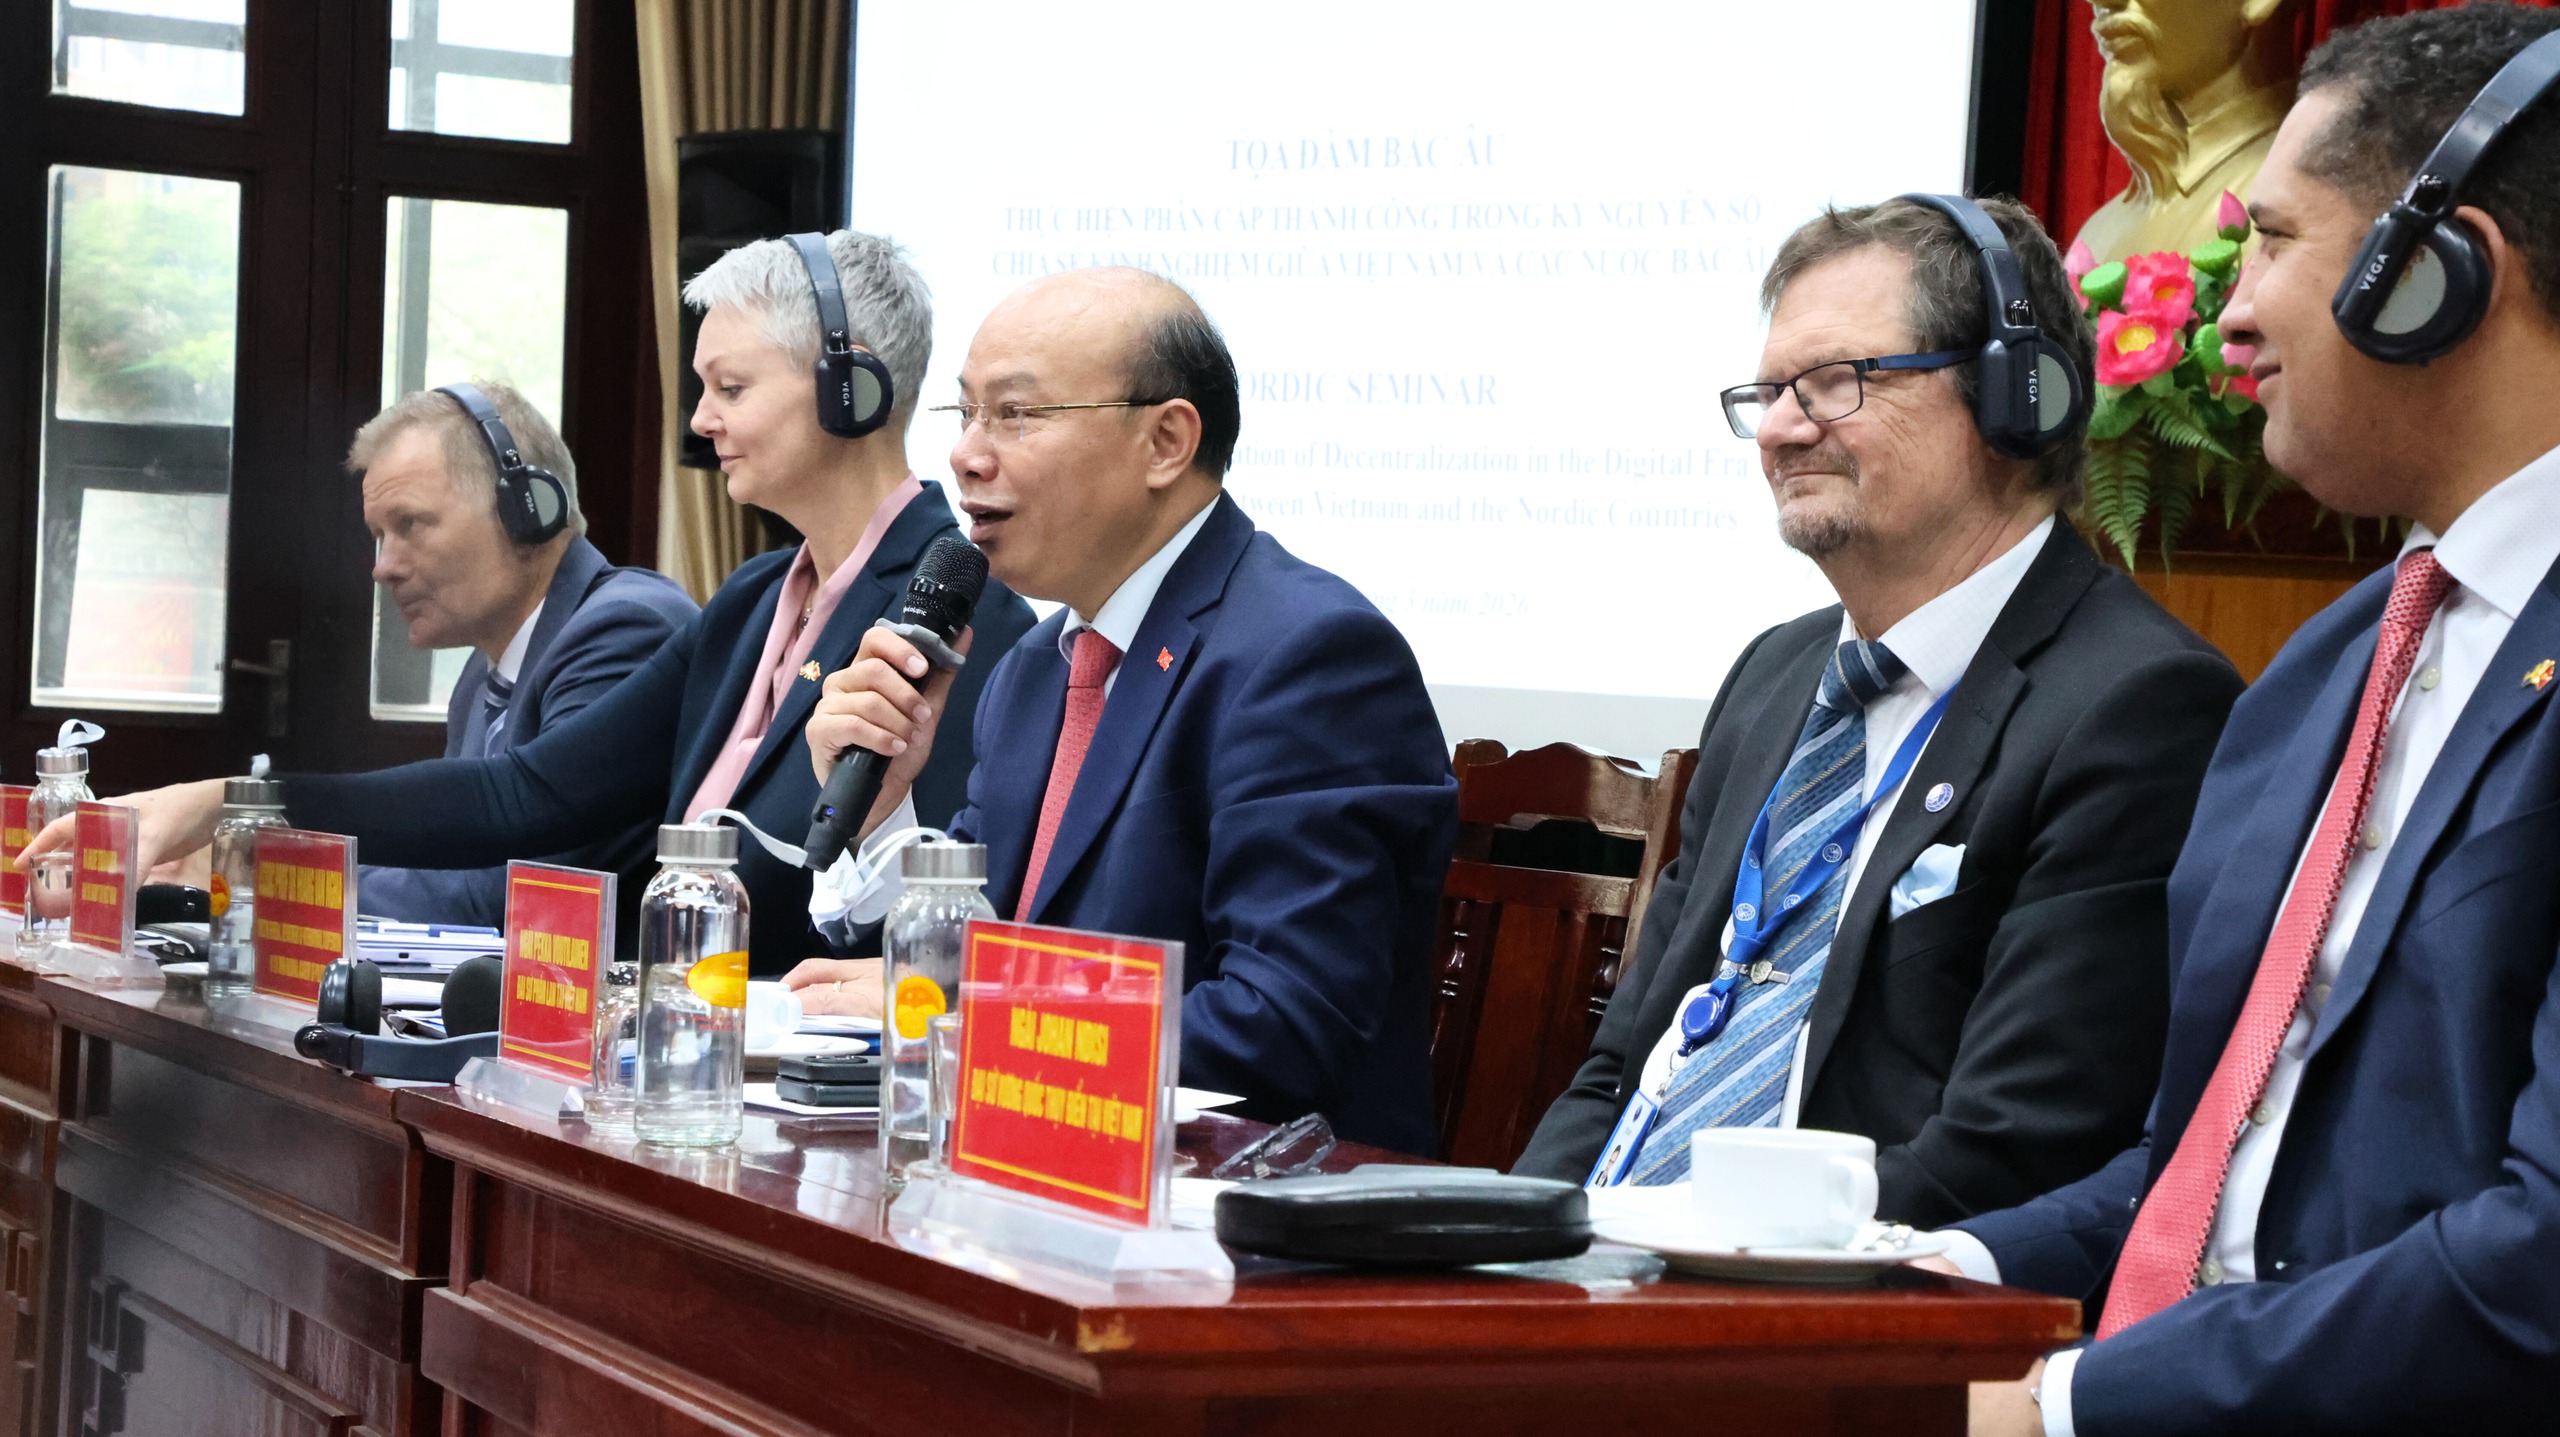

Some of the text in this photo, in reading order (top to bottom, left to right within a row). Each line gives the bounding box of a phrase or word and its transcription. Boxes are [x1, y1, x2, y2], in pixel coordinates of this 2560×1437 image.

[1449, 202, 1541, 230] TRONG
[992, 250, 1050, 276] CHIA
[1405, 251, 1463, 276] NAM
[2359, 253, 2390, 291] VEGA
[842, 381, 850, 407] VEGA
[1238, 371, 1498, 406] ORDIC SEMINAR
[2029, 369, 2038, 404] VEGA
[1294, 440, 1318, 468] of
[1325, 440, 1518, 473] Decentralization
[1527, 445, 1549, 473] in
[1558, 447, 1595, 475] the
[1604, 447, 1693, 483] Digital
[1704, 448, 1749, 478] Era
[524, 490, 535, 513] VEGA
[1313, 490, 1409, 521] Vietnam
[1417, 495, 1461, 522] and
[1471, 495, 1508, 524] the
[1518, 495, 1599, 527] Nordic
[1607, 498, 1738, 530] Countries
